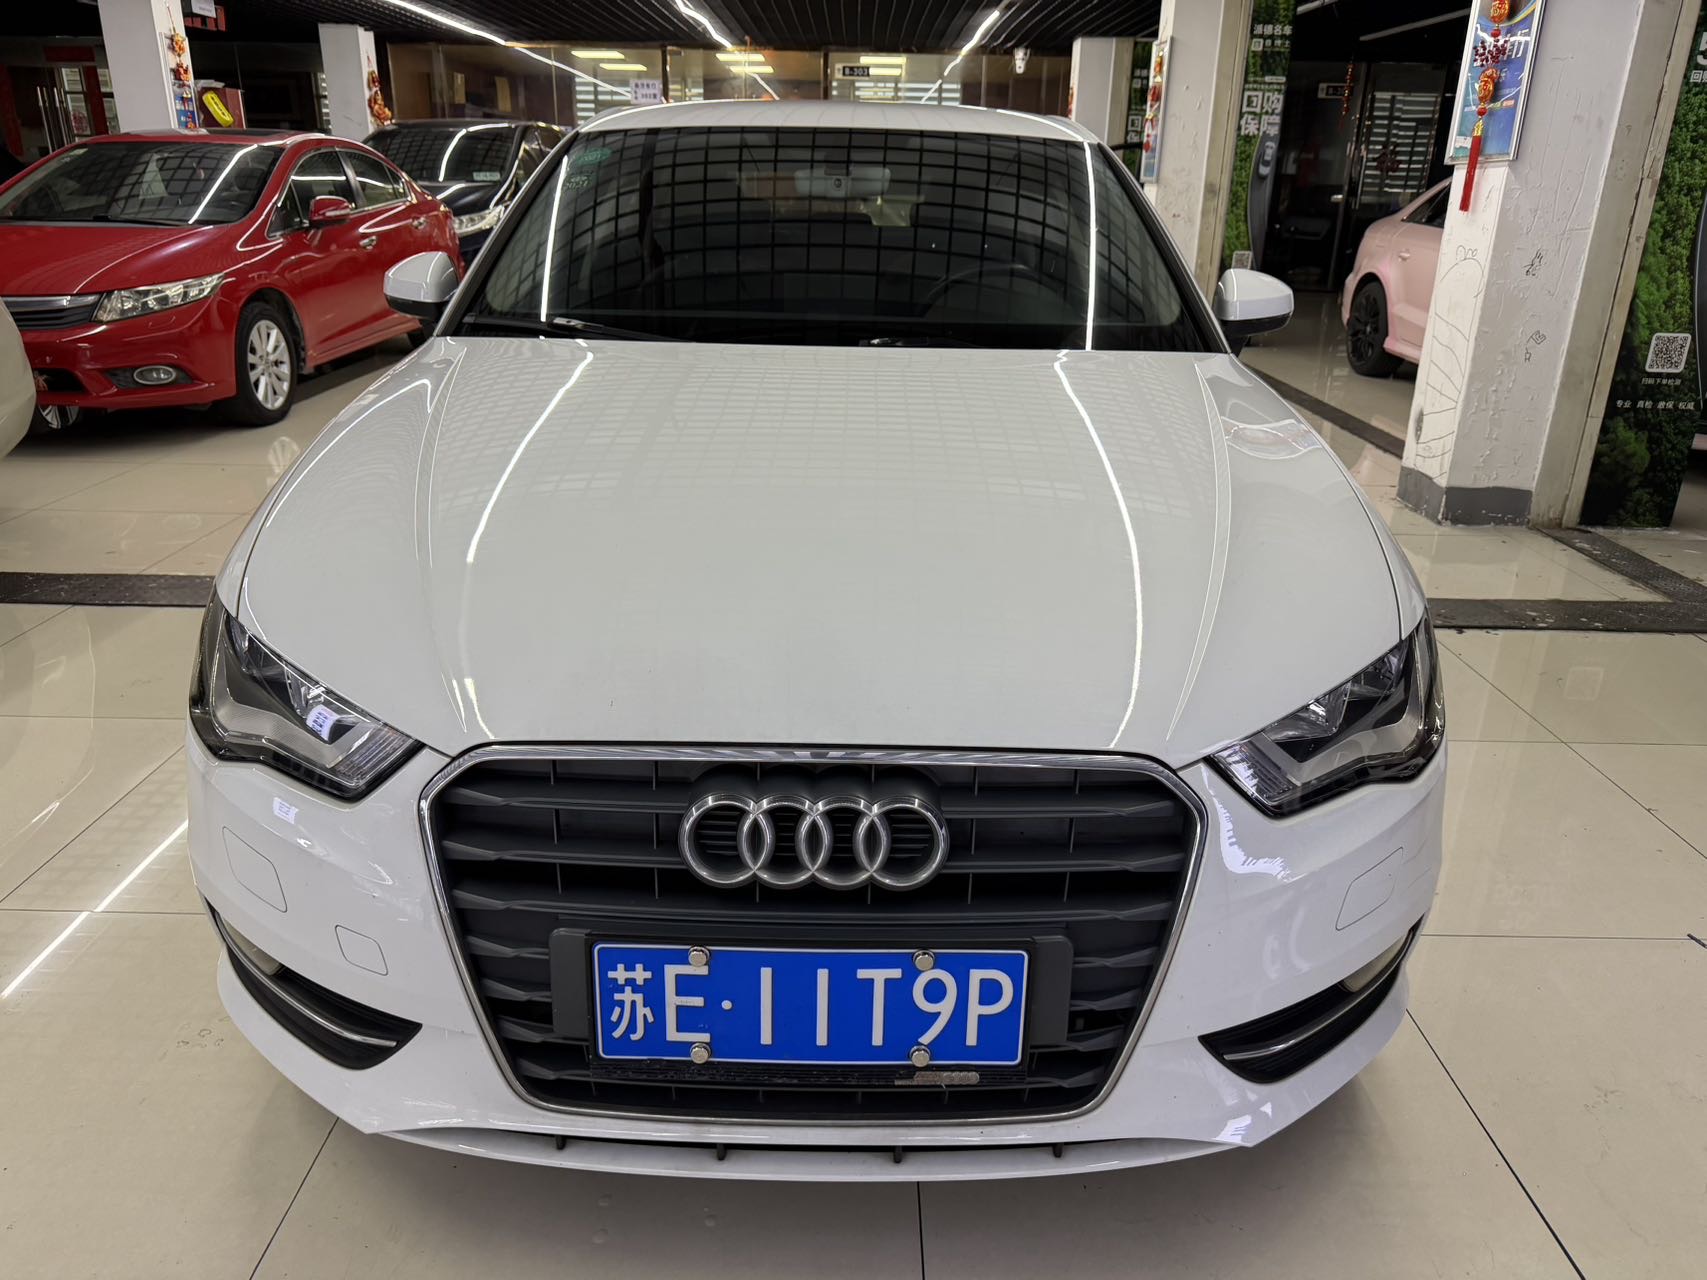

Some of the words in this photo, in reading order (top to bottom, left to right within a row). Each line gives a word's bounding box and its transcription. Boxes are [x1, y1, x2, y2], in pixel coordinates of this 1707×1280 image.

[1241, 91, 1285, 113] 回购
[1240, 114, 1281, 137] 保障
[607, 963, 1015, 1047] 苏E·11T9P
